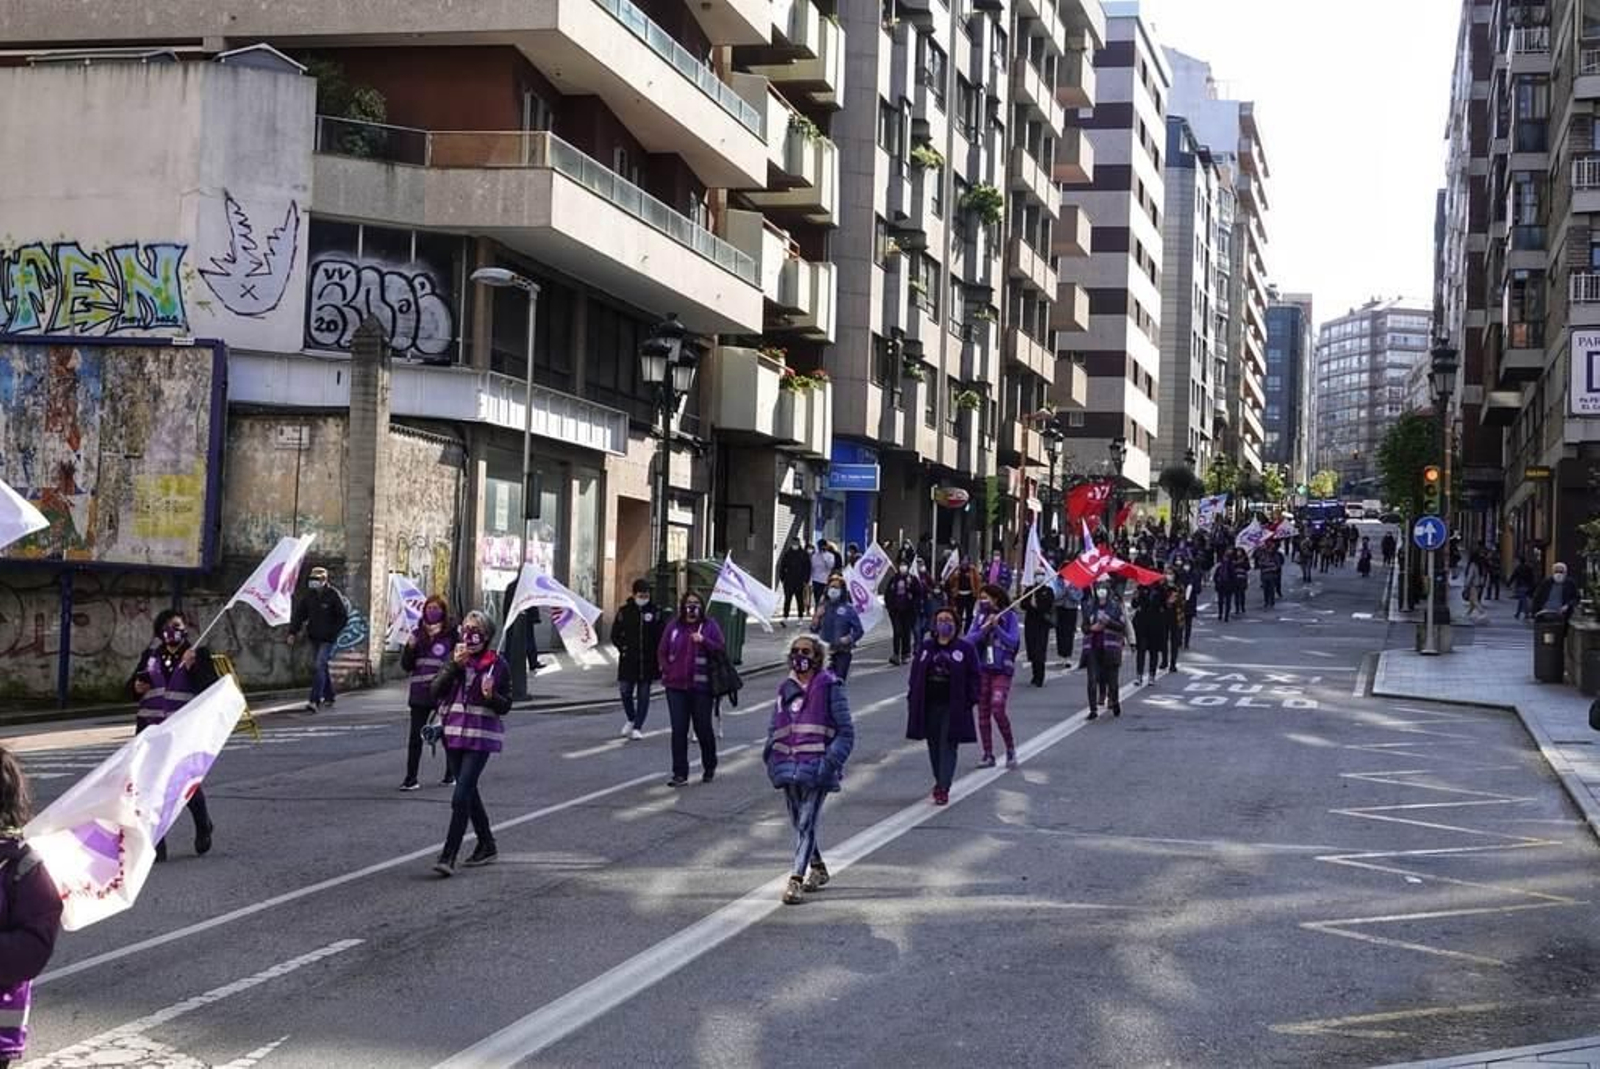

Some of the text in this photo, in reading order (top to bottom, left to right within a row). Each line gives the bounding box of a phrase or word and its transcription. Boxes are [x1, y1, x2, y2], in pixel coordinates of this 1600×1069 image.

[1188, 672, 1322, 684] TAXI
[1183, 682, 1305, 695] BUS
[1142, 694, 1319, 709] SOLO
